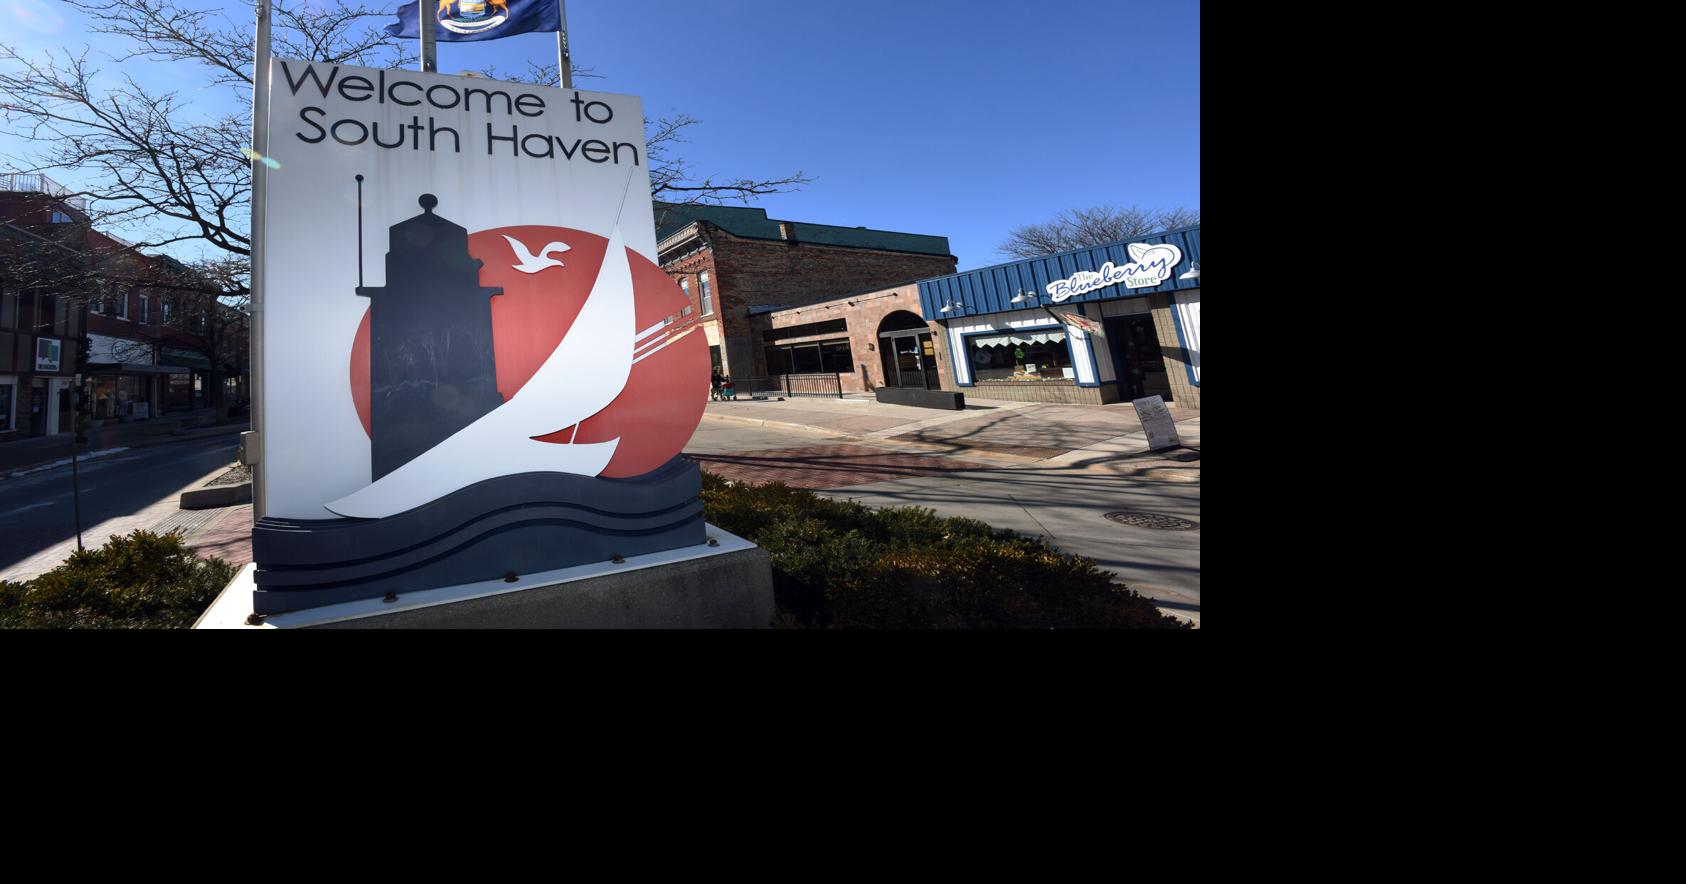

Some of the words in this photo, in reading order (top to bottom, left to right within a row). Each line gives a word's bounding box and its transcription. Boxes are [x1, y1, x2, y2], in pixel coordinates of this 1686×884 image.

[281, 61, 546, 117] Welcome
[570, 91, 613, 124] to
[296, 107, 460, 153] South
[487, 122, 639, 166] Haven
[1050, 257, 1166, 298] Blueberry
[1077, 273, 1094, 282] The
[1126, 275, 1158, 288] Store
